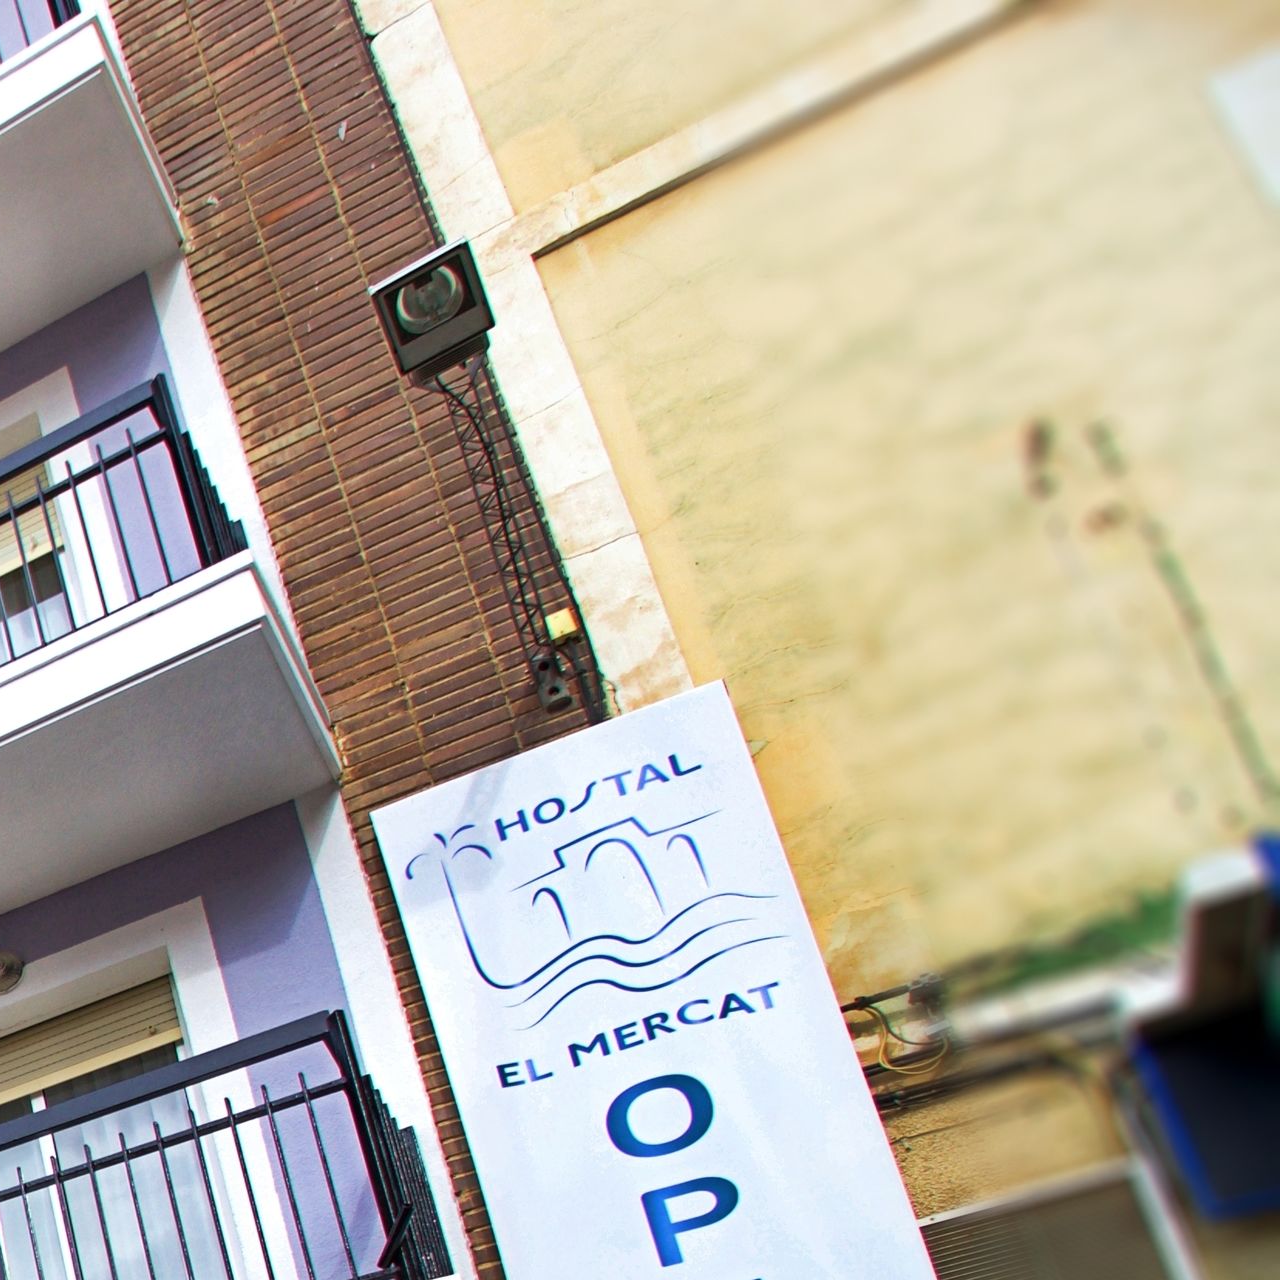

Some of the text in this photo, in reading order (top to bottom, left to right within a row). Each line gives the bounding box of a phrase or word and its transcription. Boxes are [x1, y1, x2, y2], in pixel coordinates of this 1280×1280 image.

[495, 754, 702, 841] HOSTAL
[496, 981, 780, 1088] EL MERCAT
